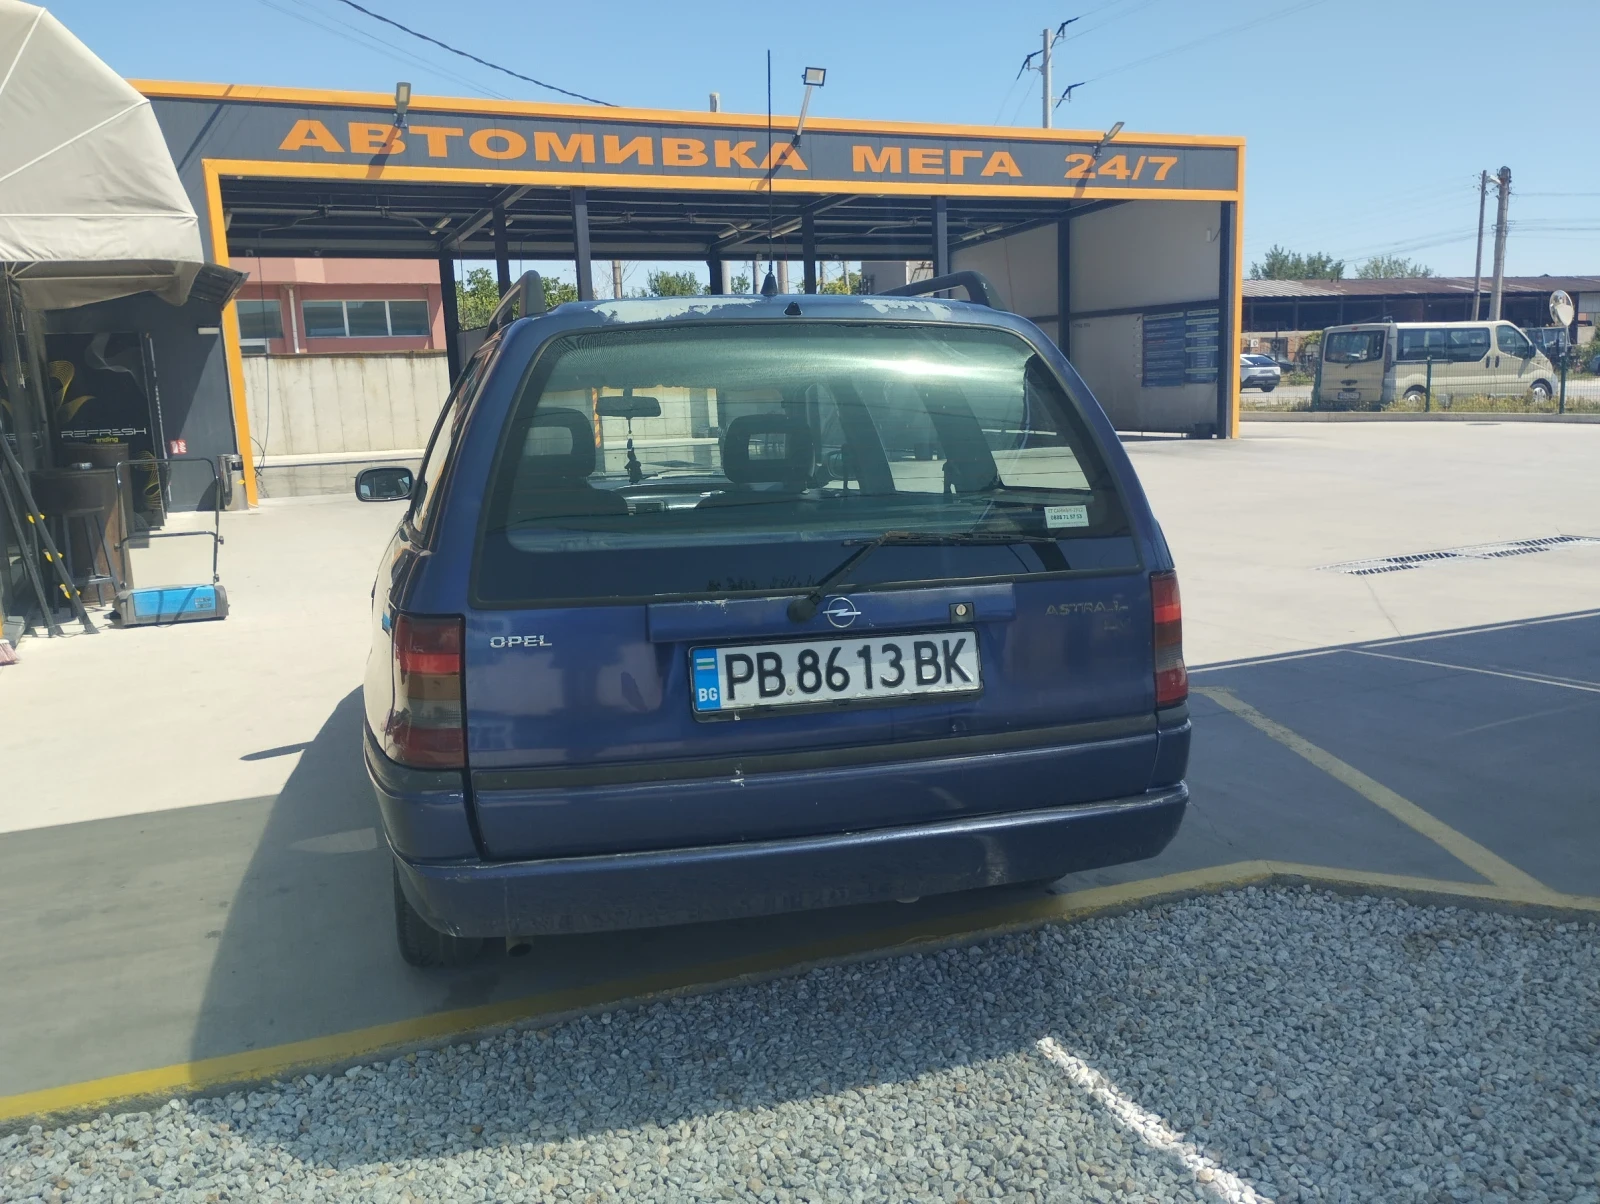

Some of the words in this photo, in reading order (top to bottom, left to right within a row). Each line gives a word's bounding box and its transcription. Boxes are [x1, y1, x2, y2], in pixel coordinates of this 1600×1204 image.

[278, 118, 808, 171] АВТОМИВКА
[851, 145, 1023, 177] МЕГА
[1063, 153, 1178, 181] 24/7
[61, 427, 147, 438] REFRESH
[1045, 601, 1106, 616] ASTRA
[490, 635, 552, 648] OPEL
[698, 688, 718, 702] BG
